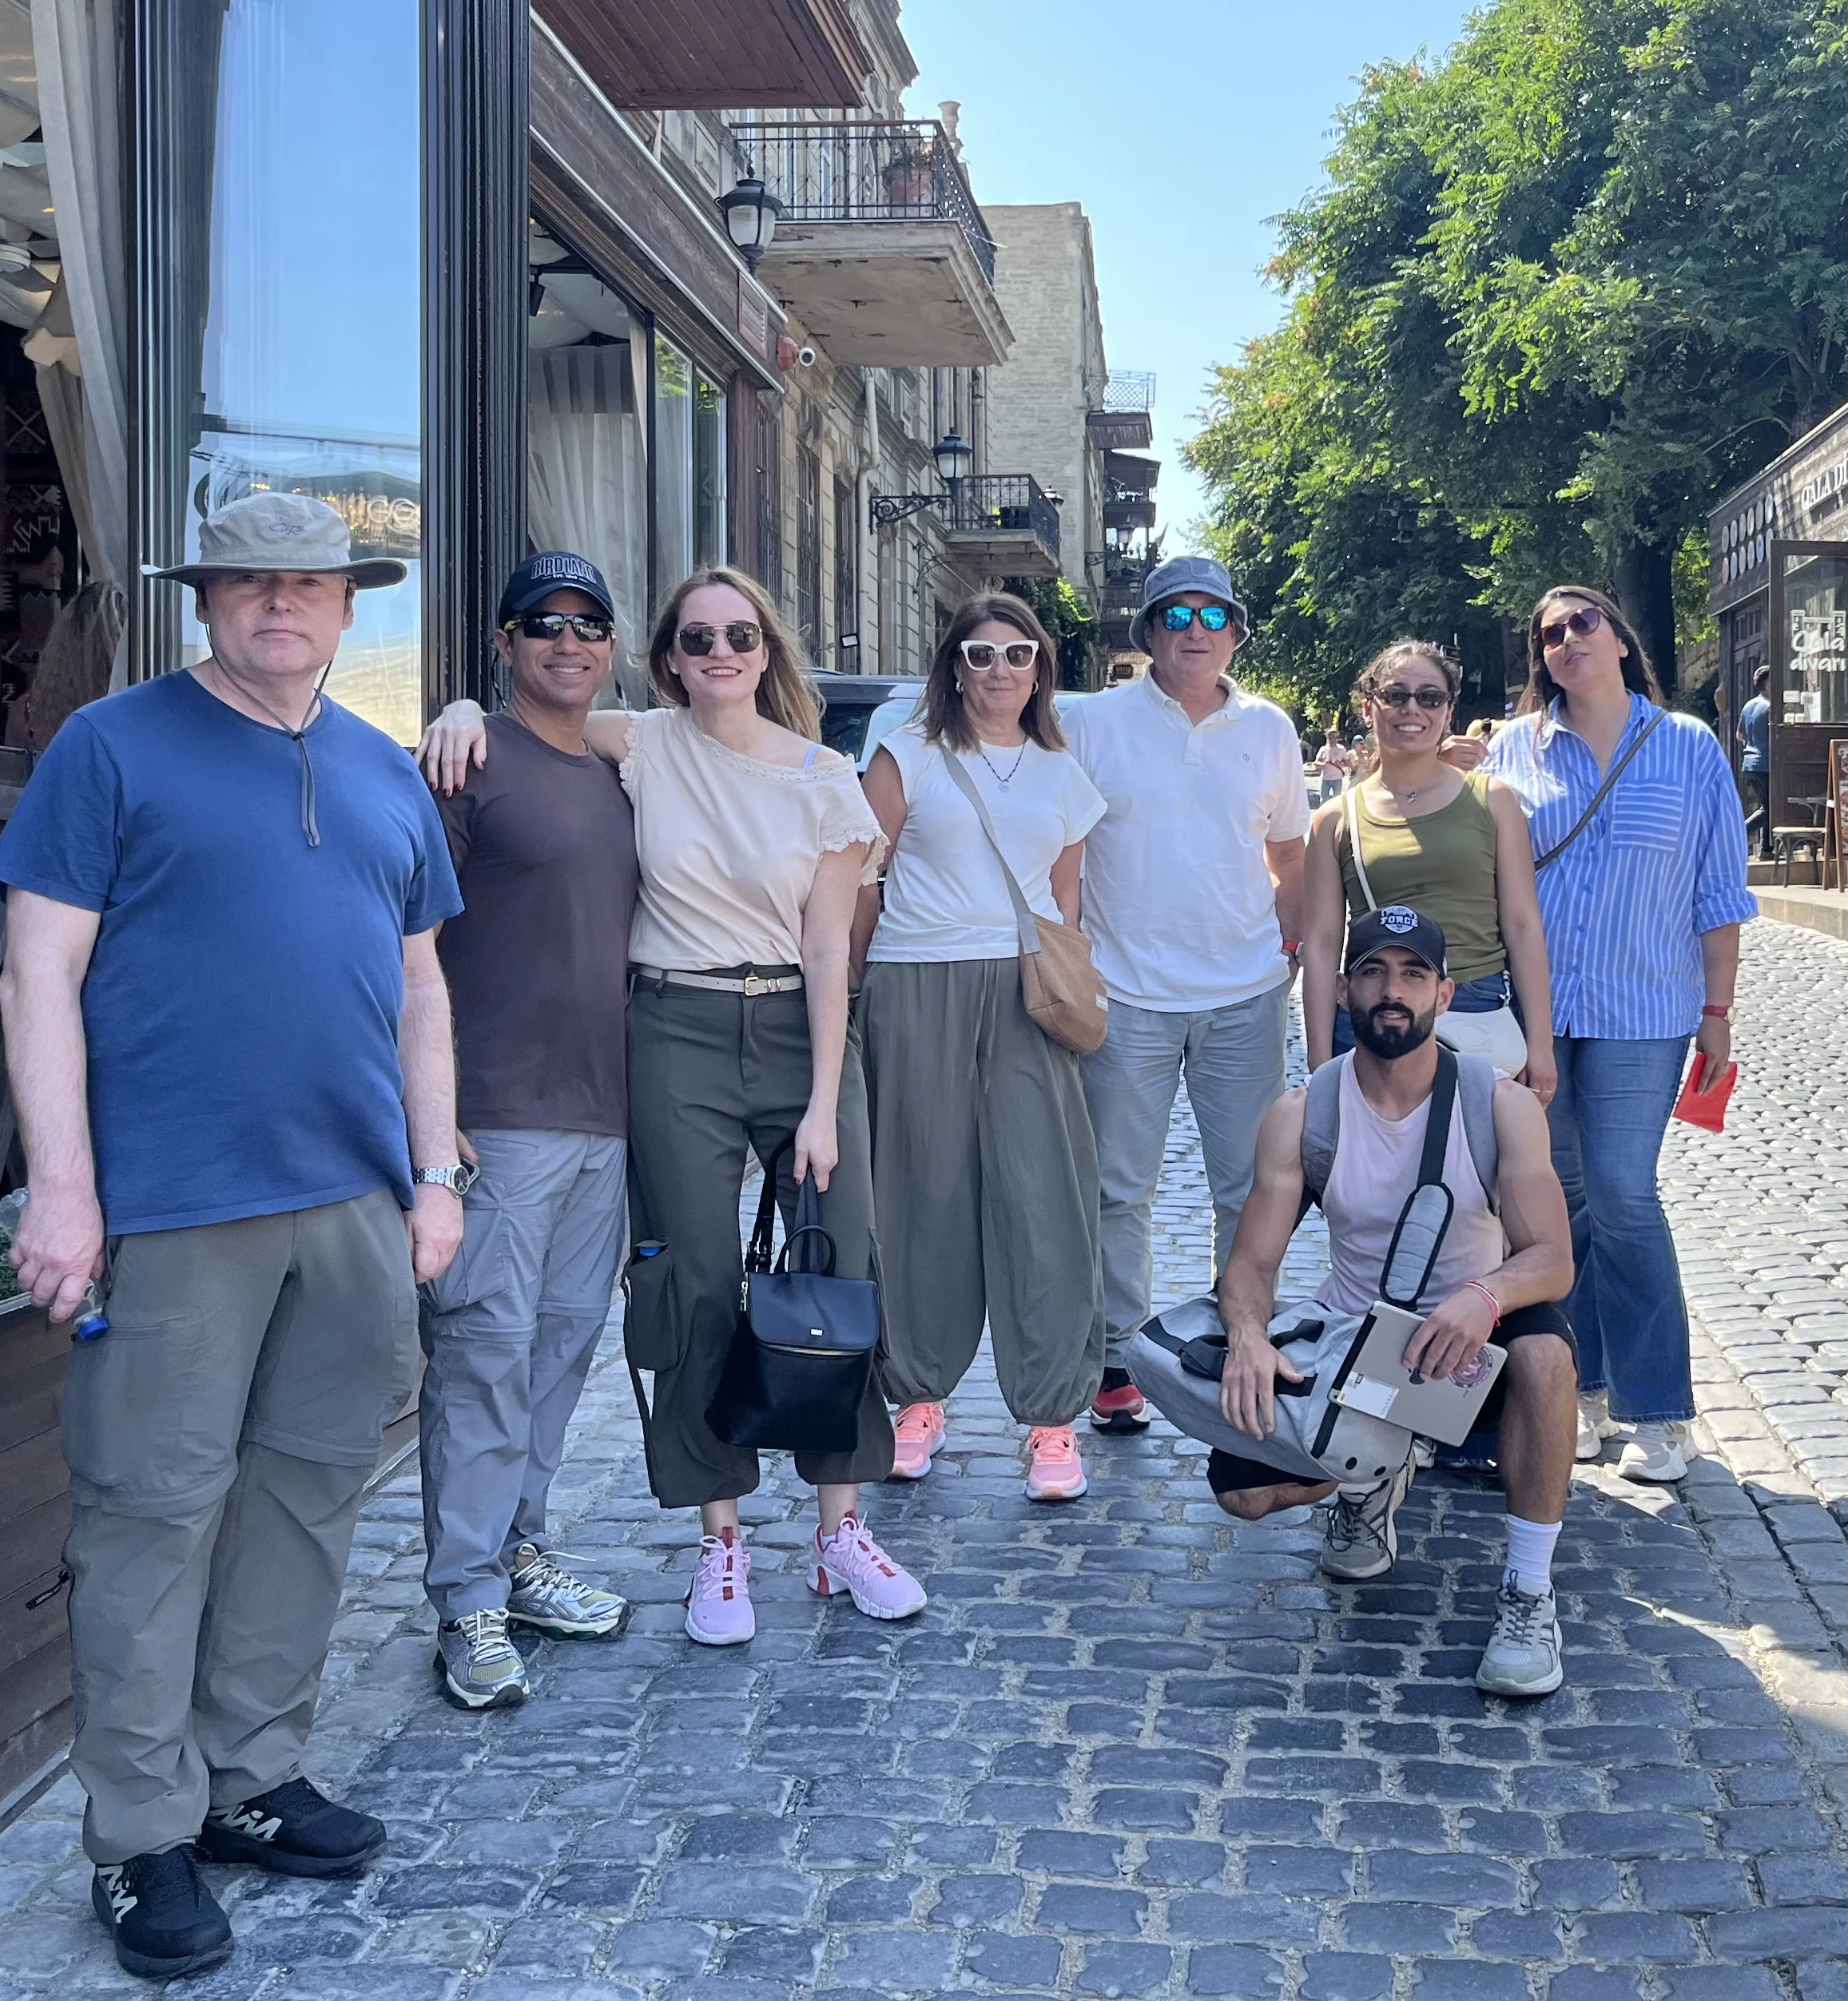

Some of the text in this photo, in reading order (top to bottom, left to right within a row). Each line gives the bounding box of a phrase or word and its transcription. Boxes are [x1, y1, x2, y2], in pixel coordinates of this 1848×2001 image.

[1801, 470, 1832, 511] QALA
[531, 556, 597, 584] BIRDLAND
[1792, 630, 1845, 654] Qala
[1380, 915, 1419, 927] FORCE
